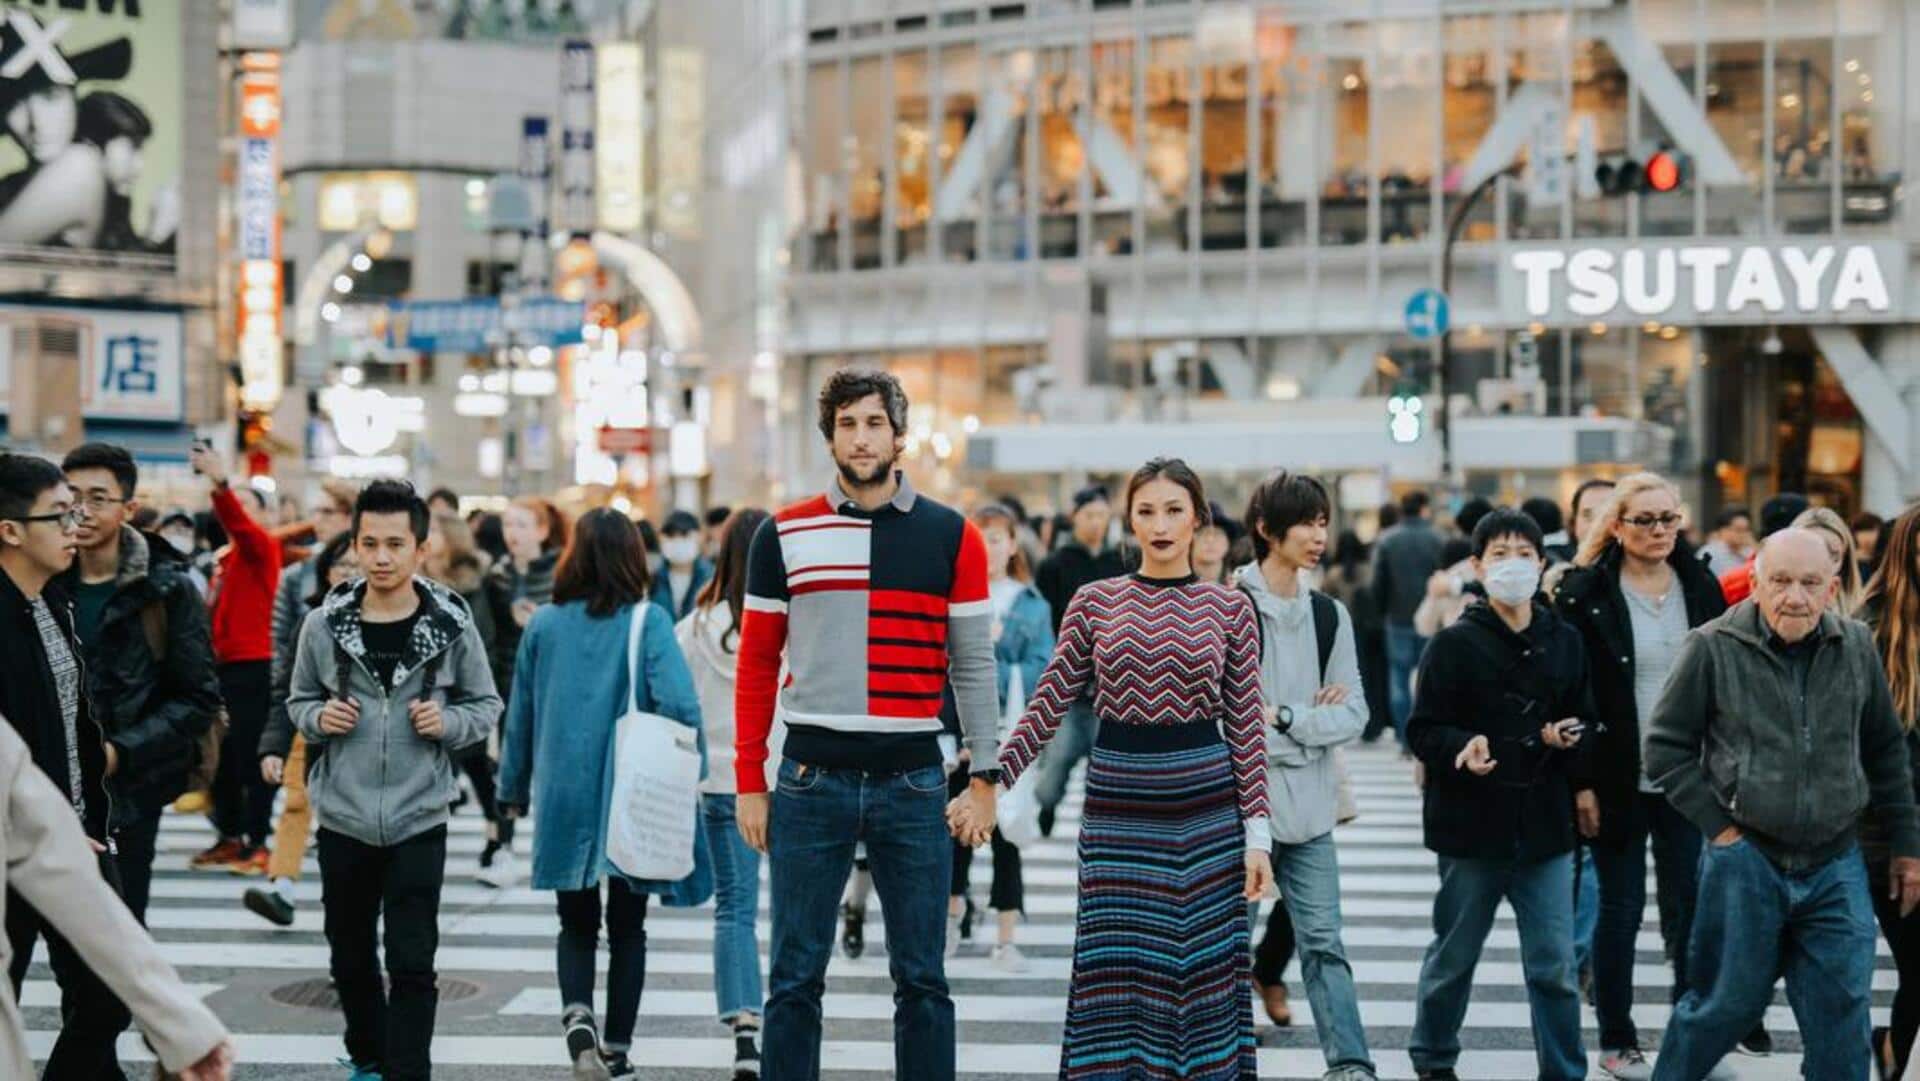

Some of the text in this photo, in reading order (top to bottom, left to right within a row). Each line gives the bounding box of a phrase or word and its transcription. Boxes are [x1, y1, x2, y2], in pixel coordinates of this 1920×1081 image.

[0, 7, 78, 87] X
[1512, 246, 1889, 316] TSUTAYA
[101, 331, 159, 393] 店
